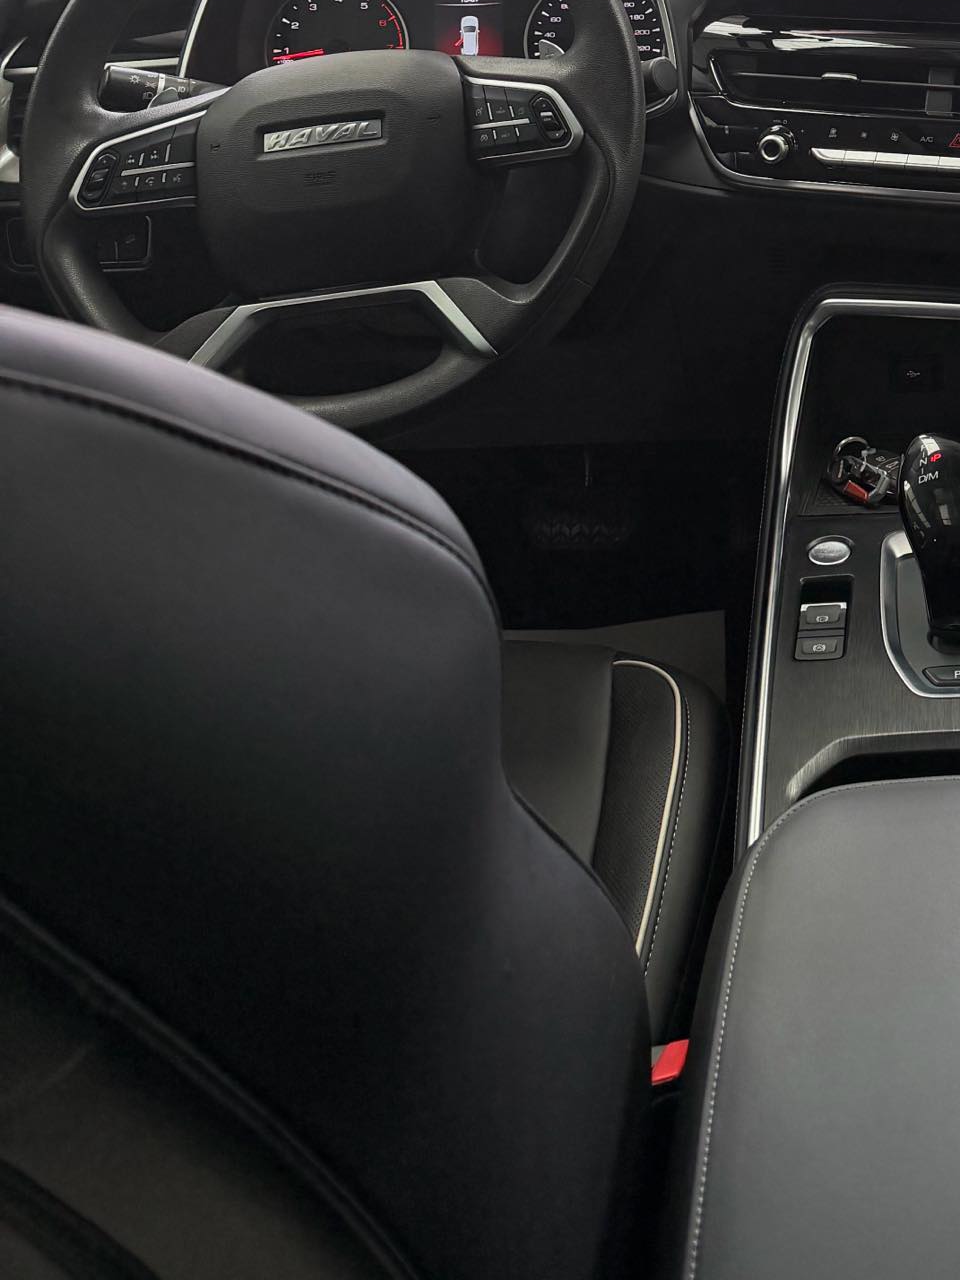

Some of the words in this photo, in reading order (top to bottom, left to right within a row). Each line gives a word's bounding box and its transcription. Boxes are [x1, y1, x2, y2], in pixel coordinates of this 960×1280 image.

[308, 3, 318, 11] 3
[360, 2, 369, 10] 5
[290, 21, 300, 29] 2
[379, 18, 388, 27] 6
[266, 122, 378, 151] HAVAL
[920, 135, 935, 144] A/C
[919, 457, 928, 467] N
